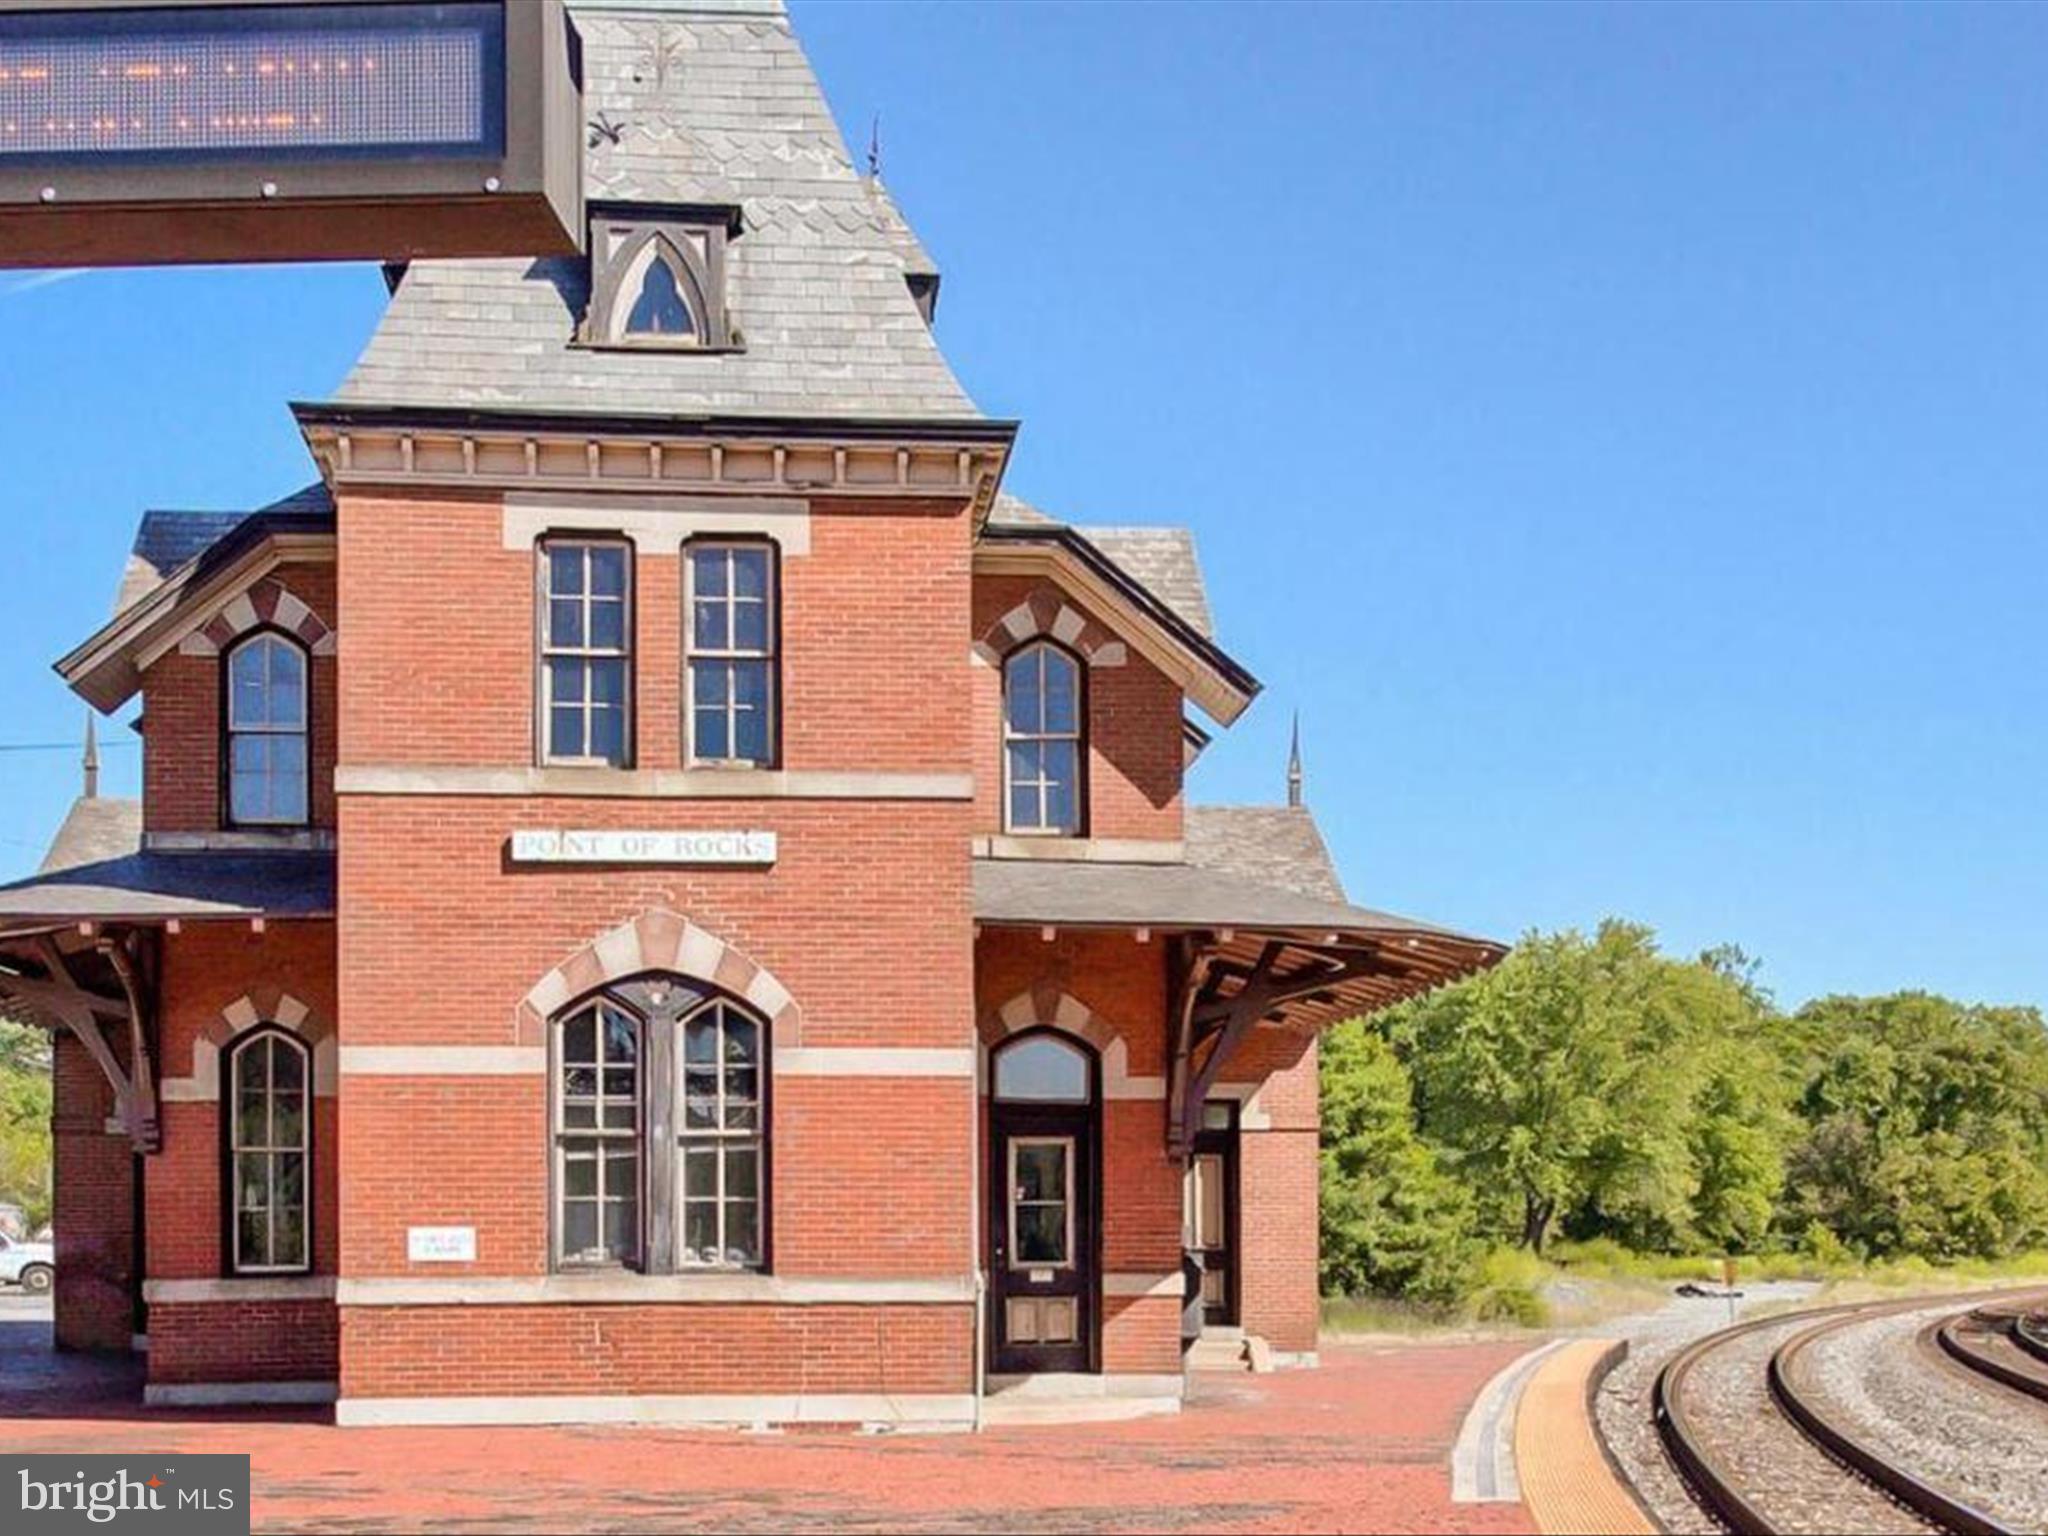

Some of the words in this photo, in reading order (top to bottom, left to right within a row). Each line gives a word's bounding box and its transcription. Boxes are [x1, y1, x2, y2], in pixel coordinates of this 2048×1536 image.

[518, 835, 603, 856] POINT
[621, 836, 660, 856] OF
[674, 836, 771, 857] ROCKS
